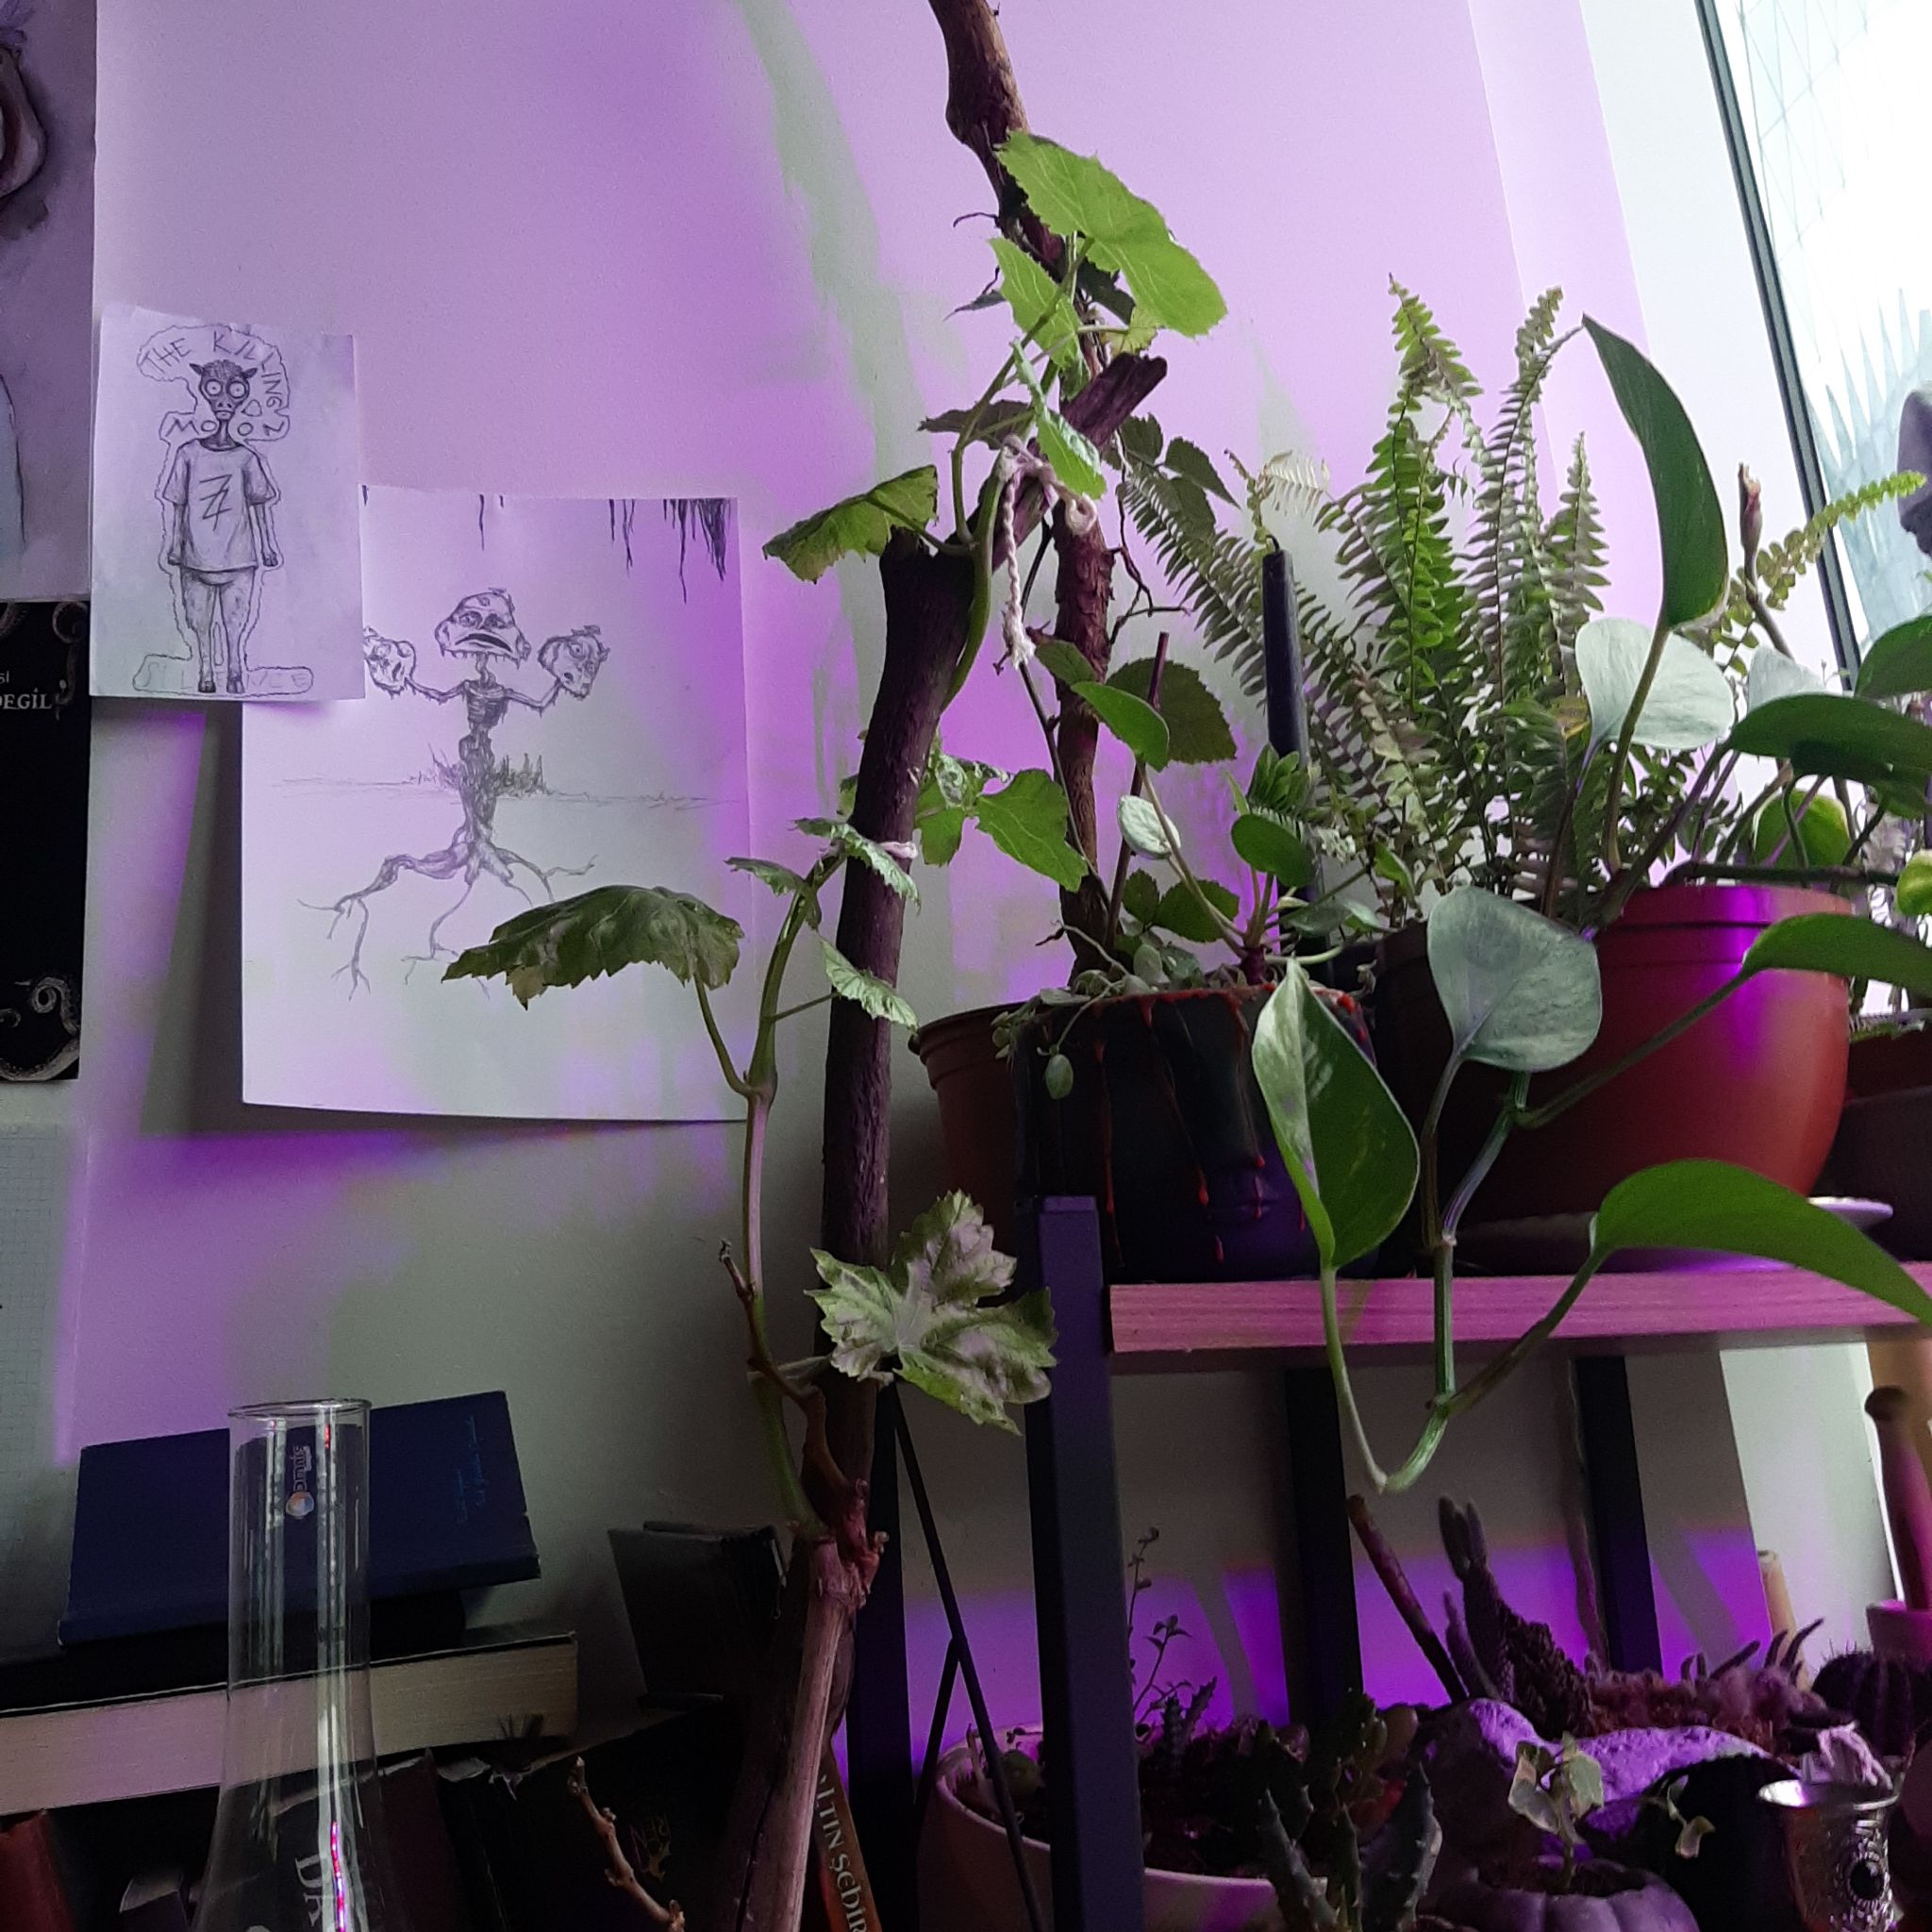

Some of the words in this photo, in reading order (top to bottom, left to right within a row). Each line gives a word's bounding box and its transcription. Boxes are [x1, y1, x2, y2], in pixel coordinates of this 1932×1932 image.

[137, 337, 192, 375] THE
[213, 330, 283, 408] KILLING
[816, 1774, 845, 1851] LTIN
